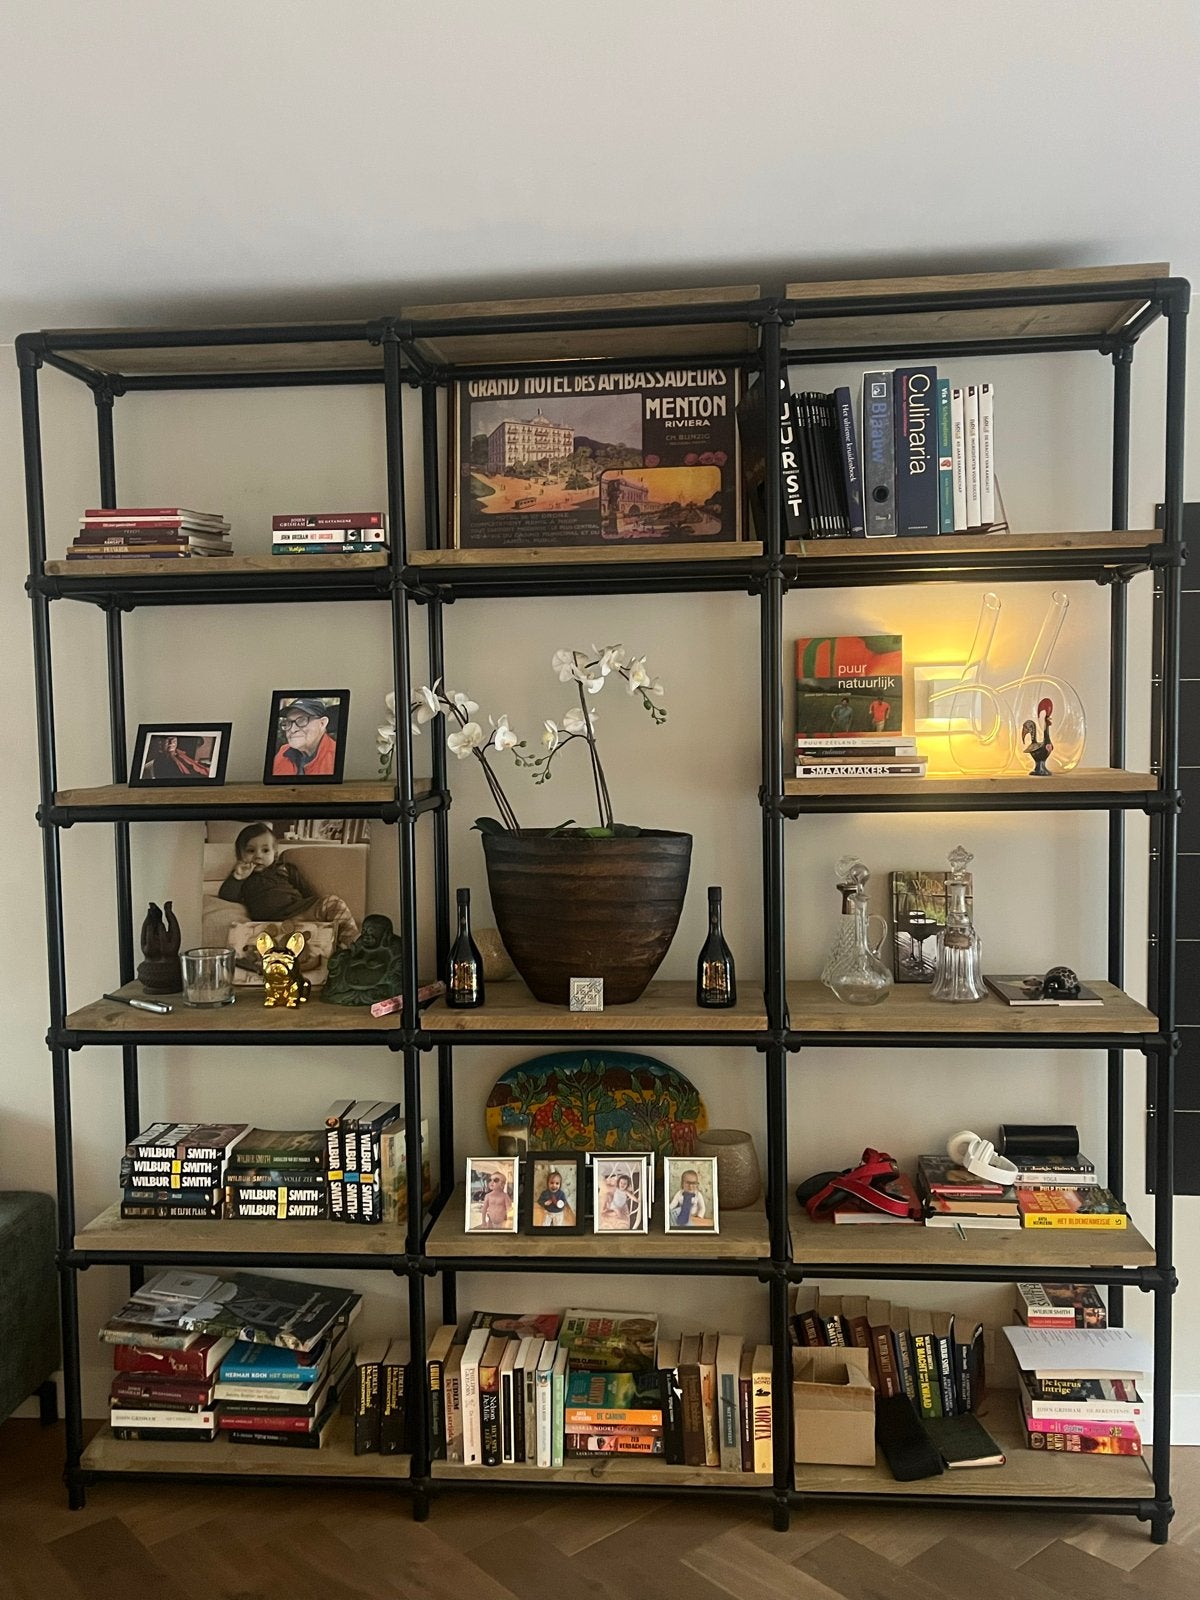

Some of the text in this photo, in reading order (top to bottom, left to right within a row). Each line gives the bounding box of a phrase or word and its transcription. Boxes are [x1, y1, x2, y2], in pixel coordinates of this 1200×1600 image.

[574, 375, 596, 393] DES
[598, 369, 727, 391] AMBASSADEURS
[646, 396, 726, 419] MENTON
[665, 420, 710, 428] RIVIERA
[843, 417, 851, 442] ultieme
[872, 403, 887, 464] Blaauw
[908, 373, 931, 475] Culinaria
[846, 442, 857, 482] kruidenboek
[838, 664, 867, 676] puur
[838, 677, 895, 690] natuurlijk
[810, 767, 890, 775] SMAAKMAKERS
[912, 879, 944, 890] WIJN
[139, 1147, 217, 1159] WILBUR SMITH
[134, 1161, 212, 1173] WILBUR SMITH
[327, 1131, 343, 1212] WILBUR SMITH
[345, 1133, 358, 1214] WILBUR SMITH
[360, 1134, 373, 1215] WILBUR SMITH
[132, 1176, 211, 1187] WILBUR SMITH
[239, 1189, 318, 1201] WILBUR SMITH
[239, 1204, 318, 1216] WILBUR SMITH
[915, 1337, 927, 1374] DE MACHT
[452, 1378, 460, 1410] LUDLUM
[1042, 1379, 1081, 1388] De Icarus
[1042, 1386, 1071, 1395] Intrige
[921, 1383, 933, 1409] KWAAD
[489, 1396, 497, 1420] Nelson
[754, 1405, 772, 1440] VORTEX
[619, 1442, 651, 1450] VERDACHTEN
